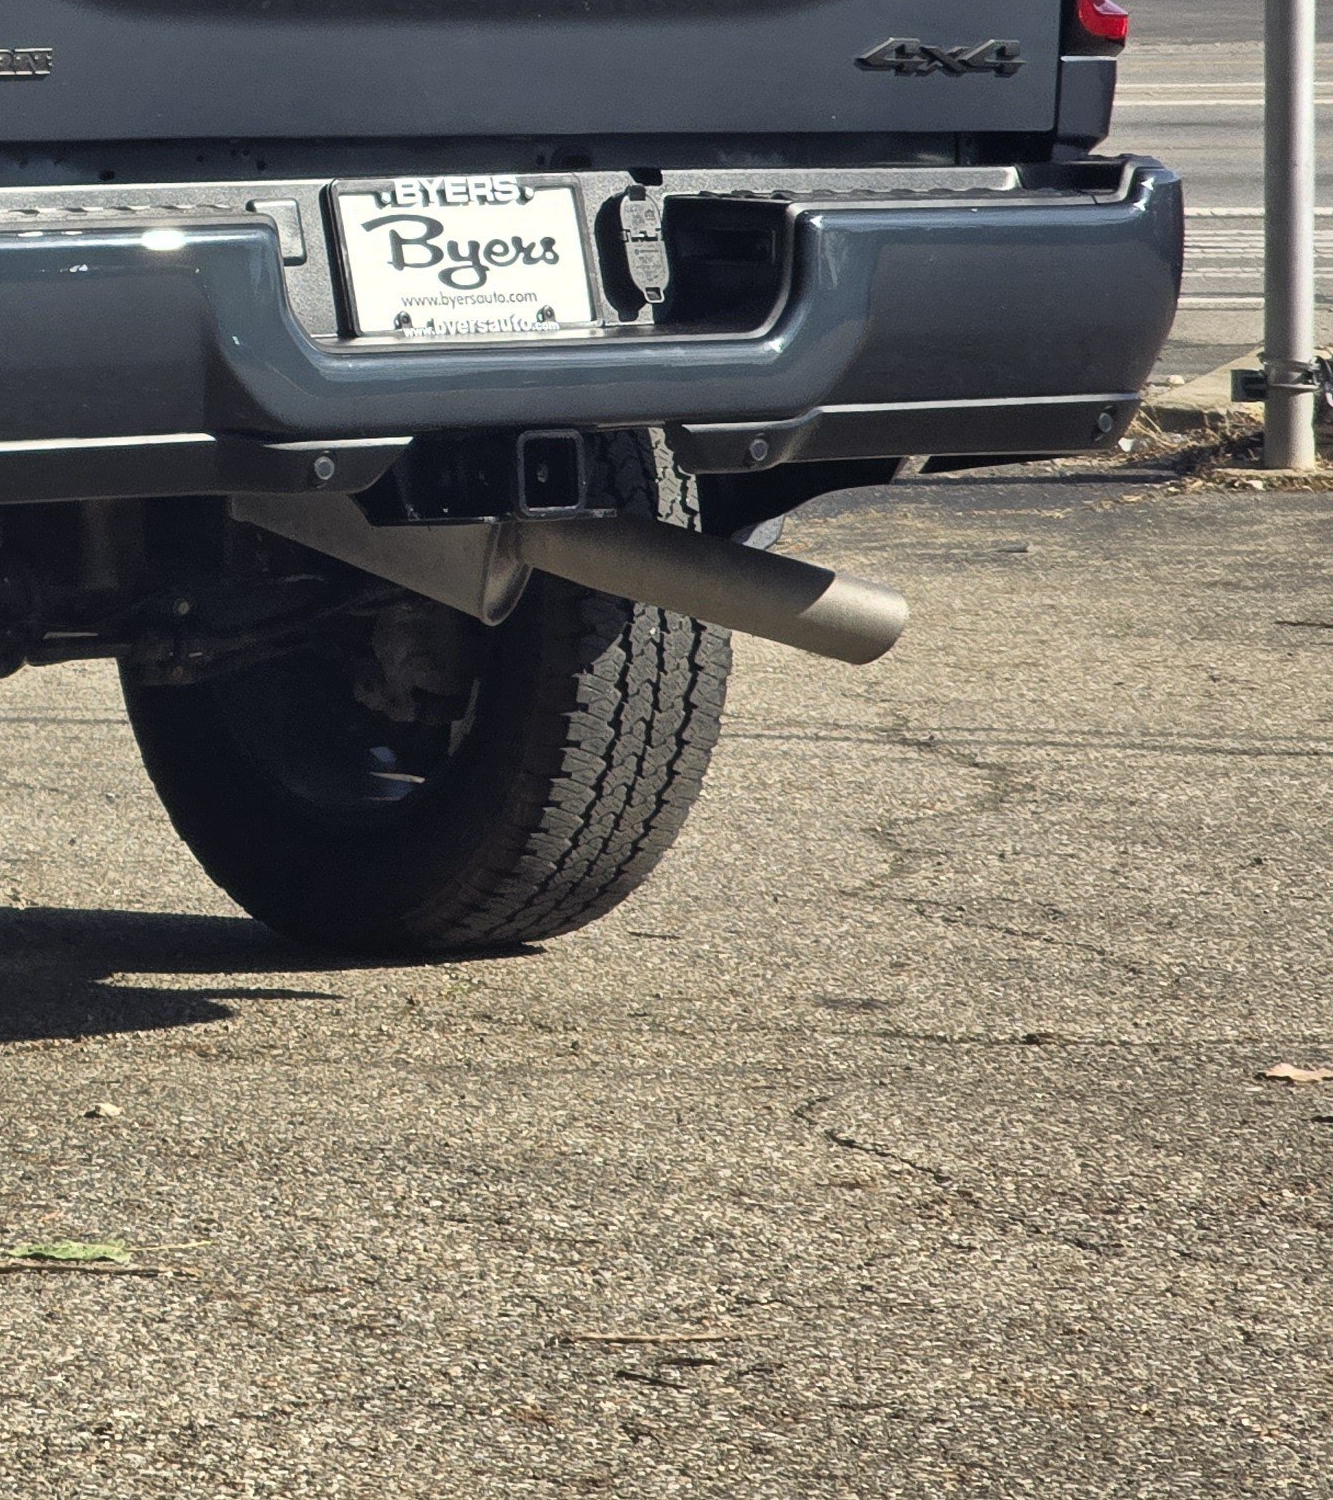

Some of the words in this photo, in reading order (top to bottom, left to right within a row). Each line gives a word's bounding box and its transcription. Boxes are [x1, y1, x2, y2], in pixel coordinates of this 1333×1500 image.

[853, 36, 1027, 78] 4x4
[393, 175, 520, 205] BYERS
[360, 213, 560, 290] Byers
[400, 290, 538, 309] www.byersauto.com
